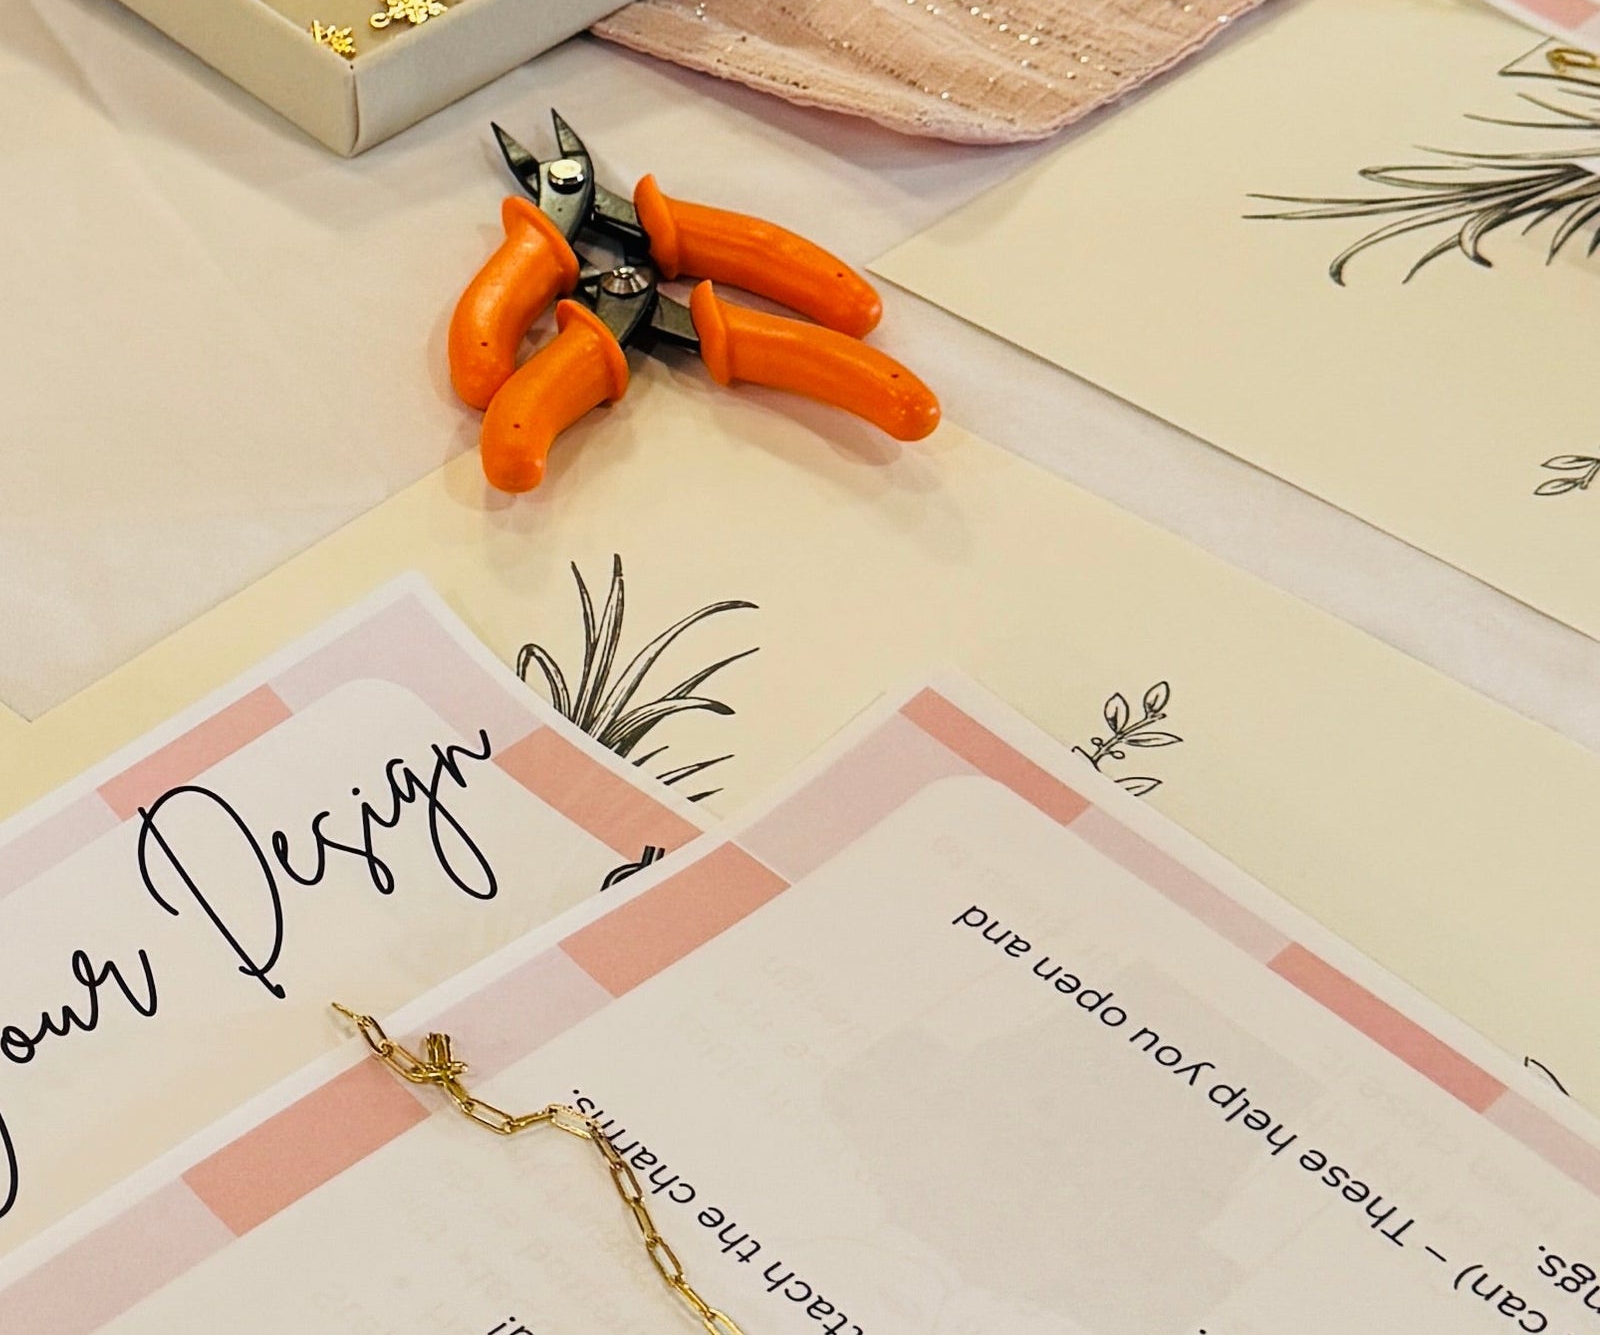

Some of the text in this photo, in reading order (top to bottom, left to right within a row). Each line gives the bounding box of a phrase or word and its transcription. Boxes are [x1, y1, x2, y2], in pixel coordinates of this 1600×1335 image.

[137, 727, 499, 999] Design
[952, 905, 1033, 958] and
[1033, 957, 1127, 1027] open
[1129, 1026, 1215, 1088] you
[568, 1089, 696, 1203] charms.
[1209, 1083, 1297, 1155] help
[1299, 1148, 1416, 1248] These
[697, 1206, 761, 1265] the
[1453, 1264, 1548, 1333] can)
